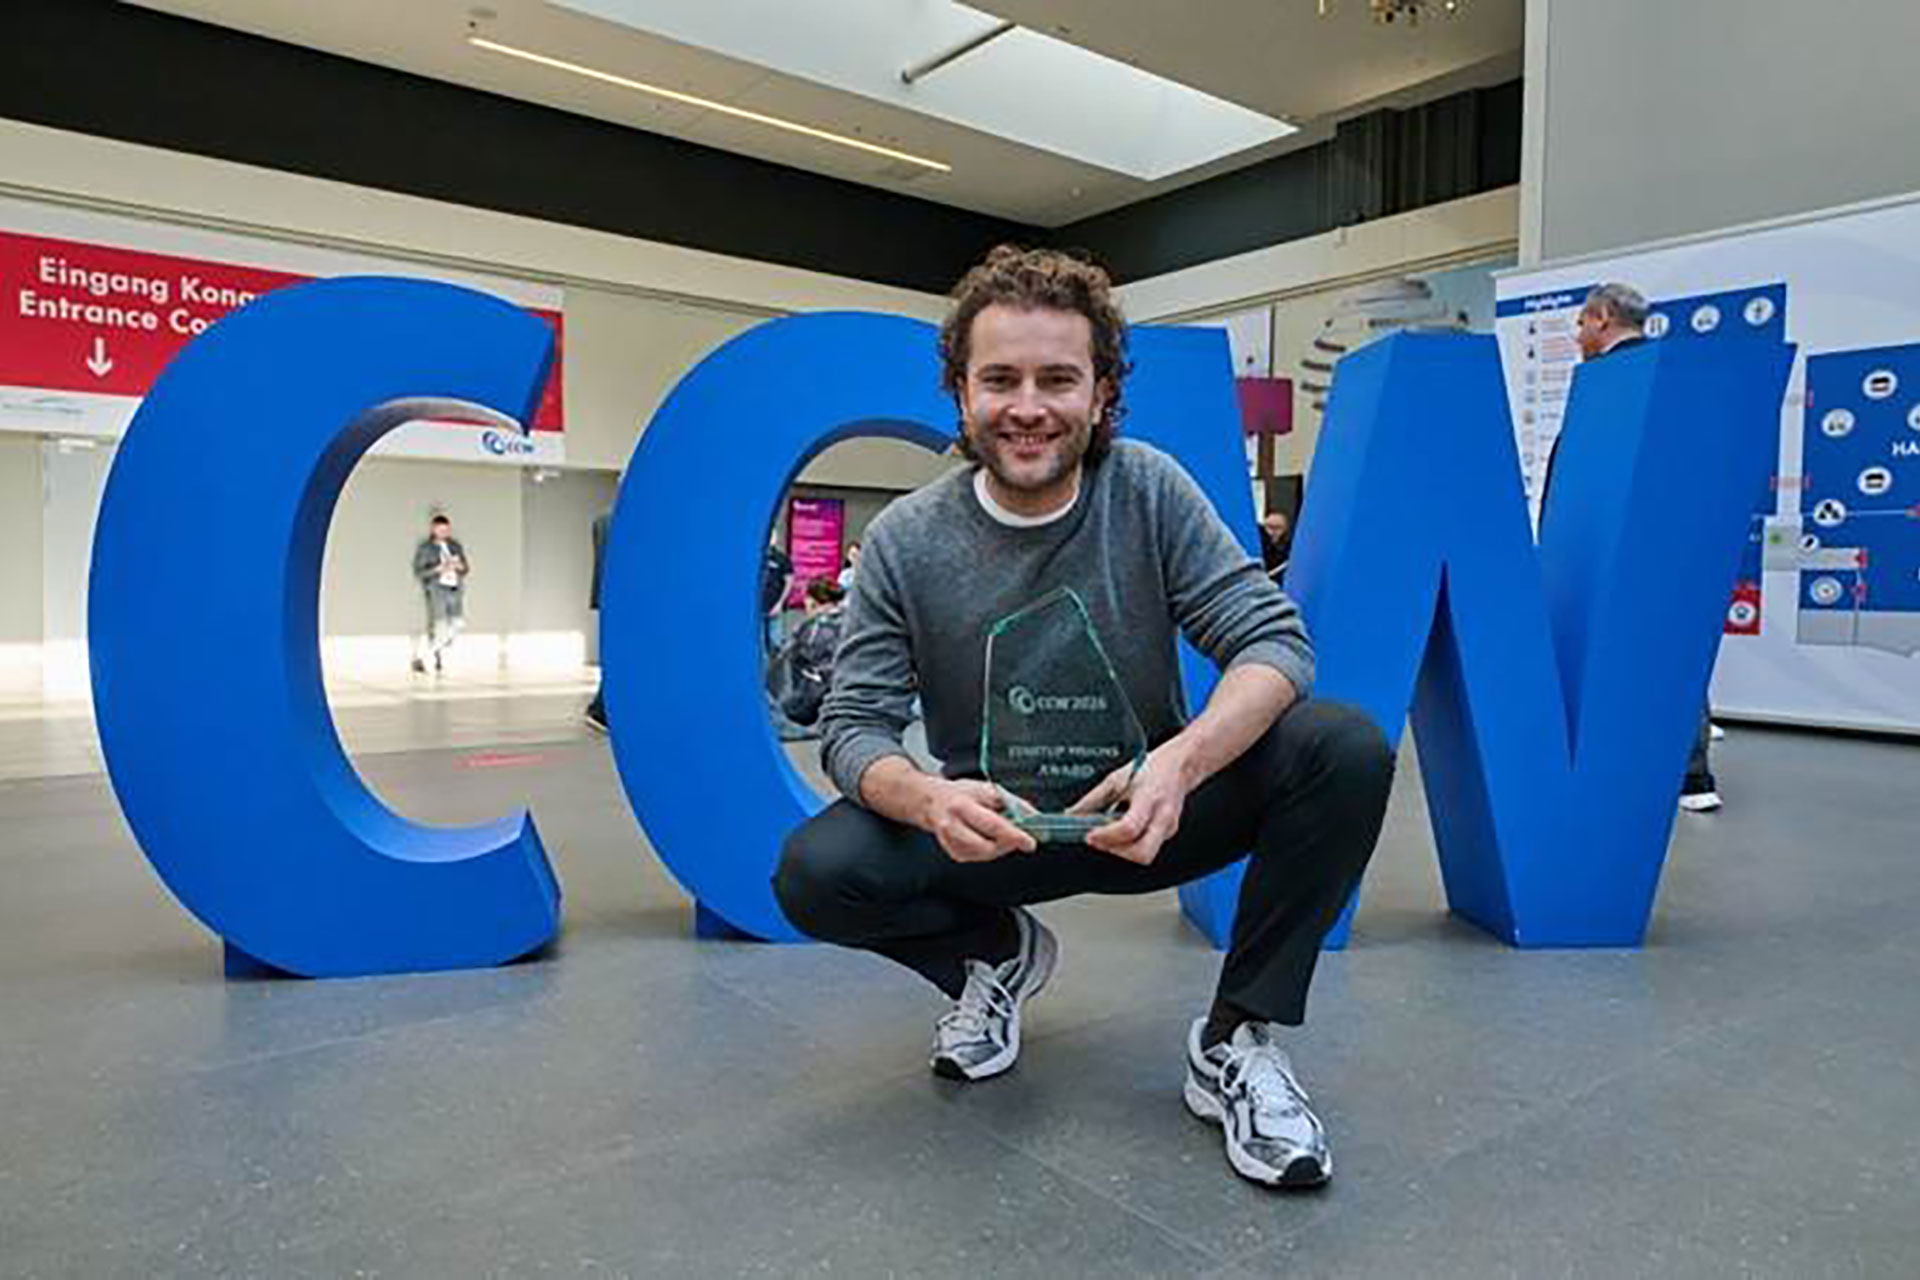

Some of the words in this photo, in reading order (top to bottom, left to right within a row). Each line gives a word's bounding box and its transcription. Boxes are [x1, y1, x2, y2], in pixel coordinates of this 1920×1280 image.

[39, 256, 168, 304] Eingang
[19, 290, 158, 330] Entrance
[1040, 764, 1095, 777] AWARD
